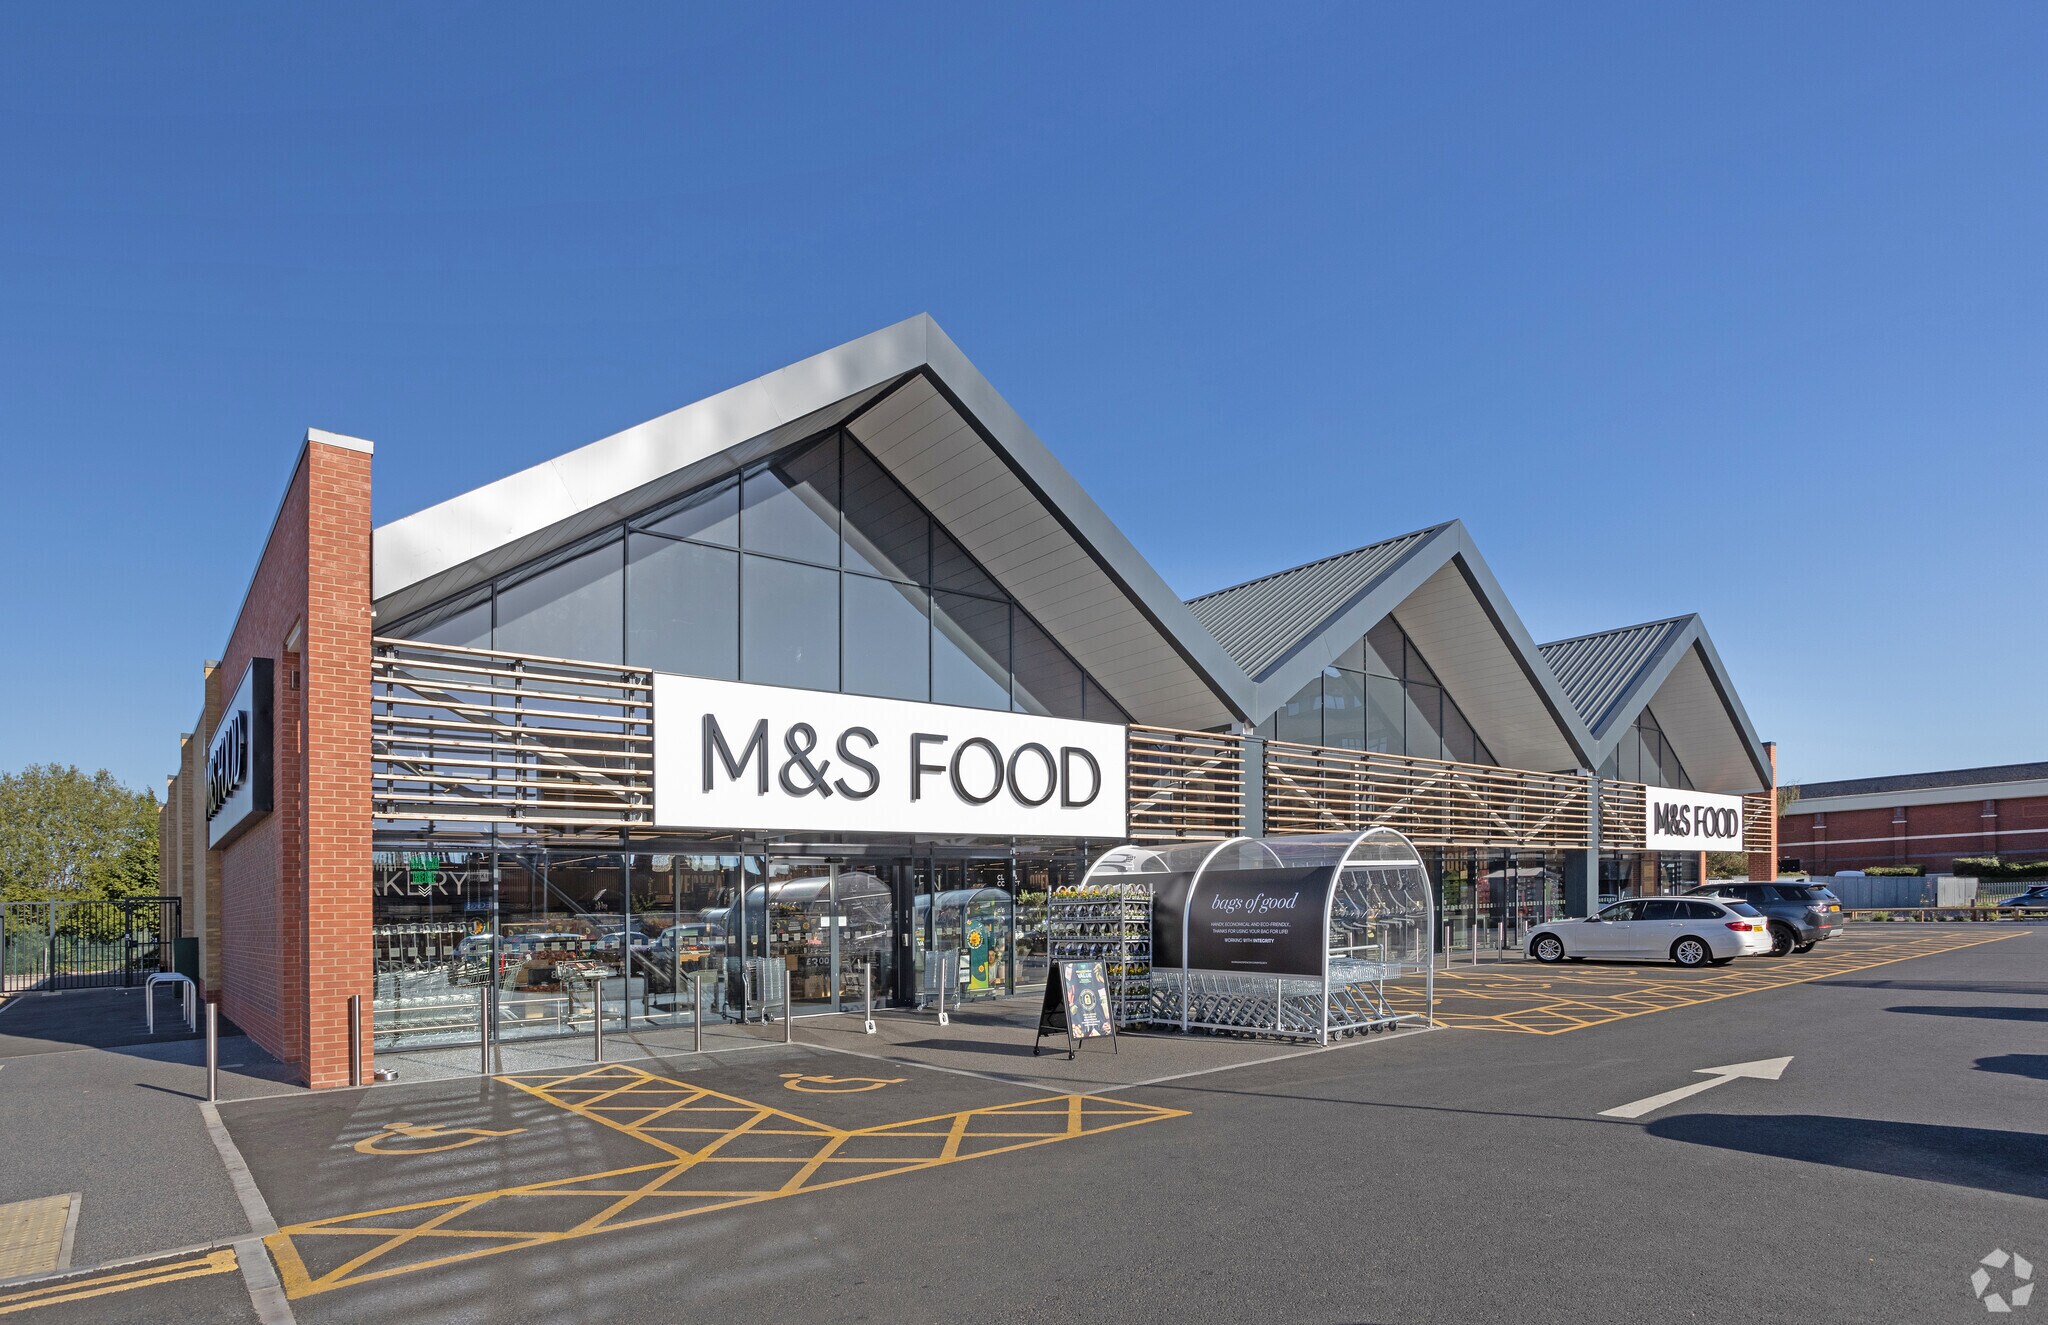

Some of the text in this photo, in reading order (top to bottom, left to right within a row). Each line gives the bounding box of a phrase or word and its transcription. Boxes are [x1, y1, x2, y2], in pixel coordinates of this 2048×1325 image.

[702, 713, 1102, 808] M&S FOOD
[1653, 801, 1739, 839] M&S FOOD
[1211, 892, 1299, 914] bags of good
